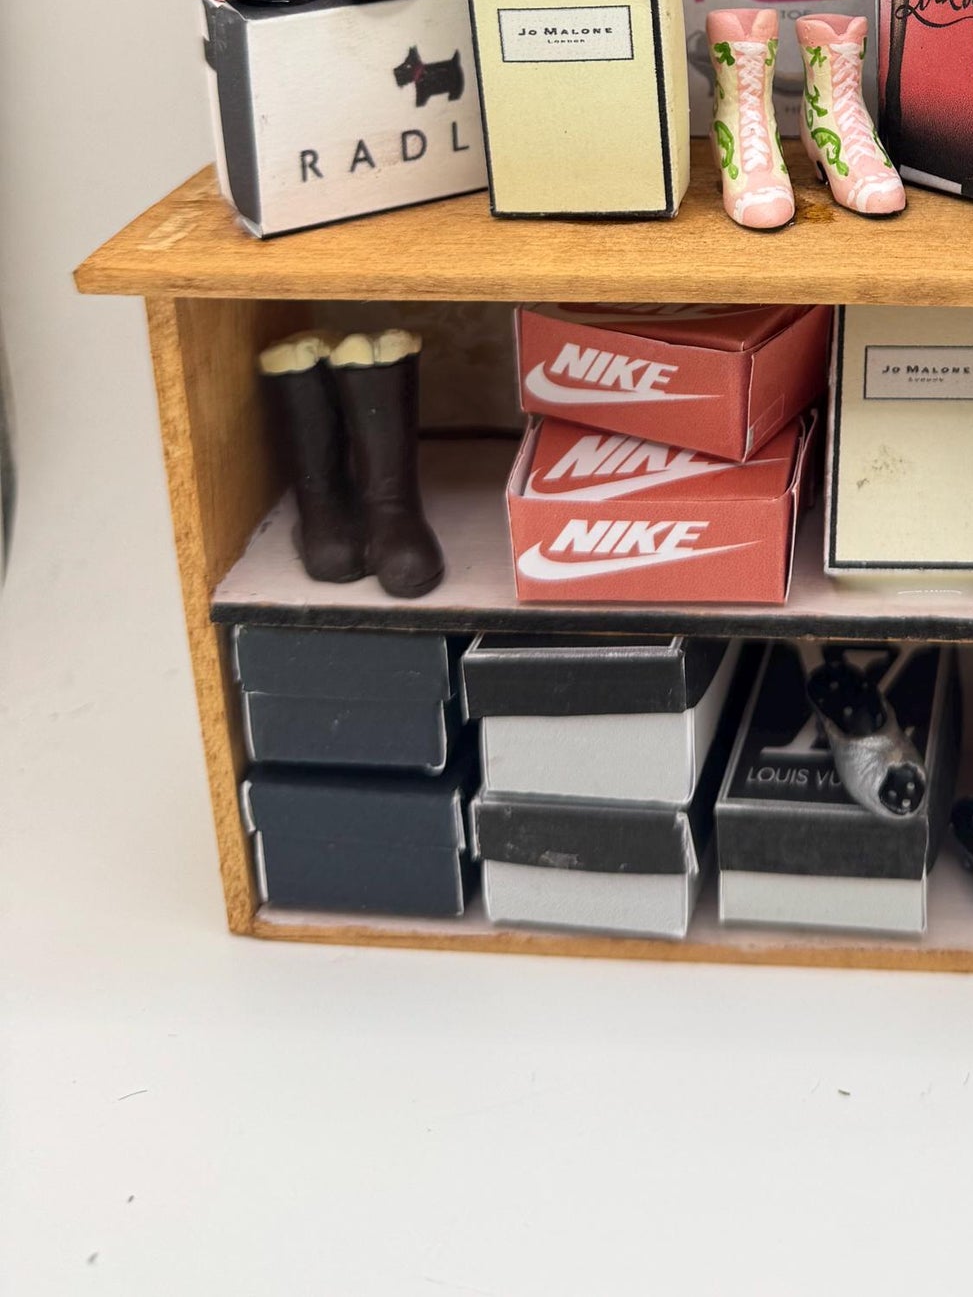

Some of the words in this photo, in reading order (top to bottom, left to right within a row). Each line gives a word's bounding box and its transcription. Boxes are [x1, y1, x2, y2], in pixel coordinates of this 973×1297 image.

[544, 27, 613, 36] MALONE
[550, 342, 679, 394] NIKE
[906, 365, 971, 374] MALONE
[549, 518, 710, 554] NIKE
[746, 766, 809, 785] LOUIS
